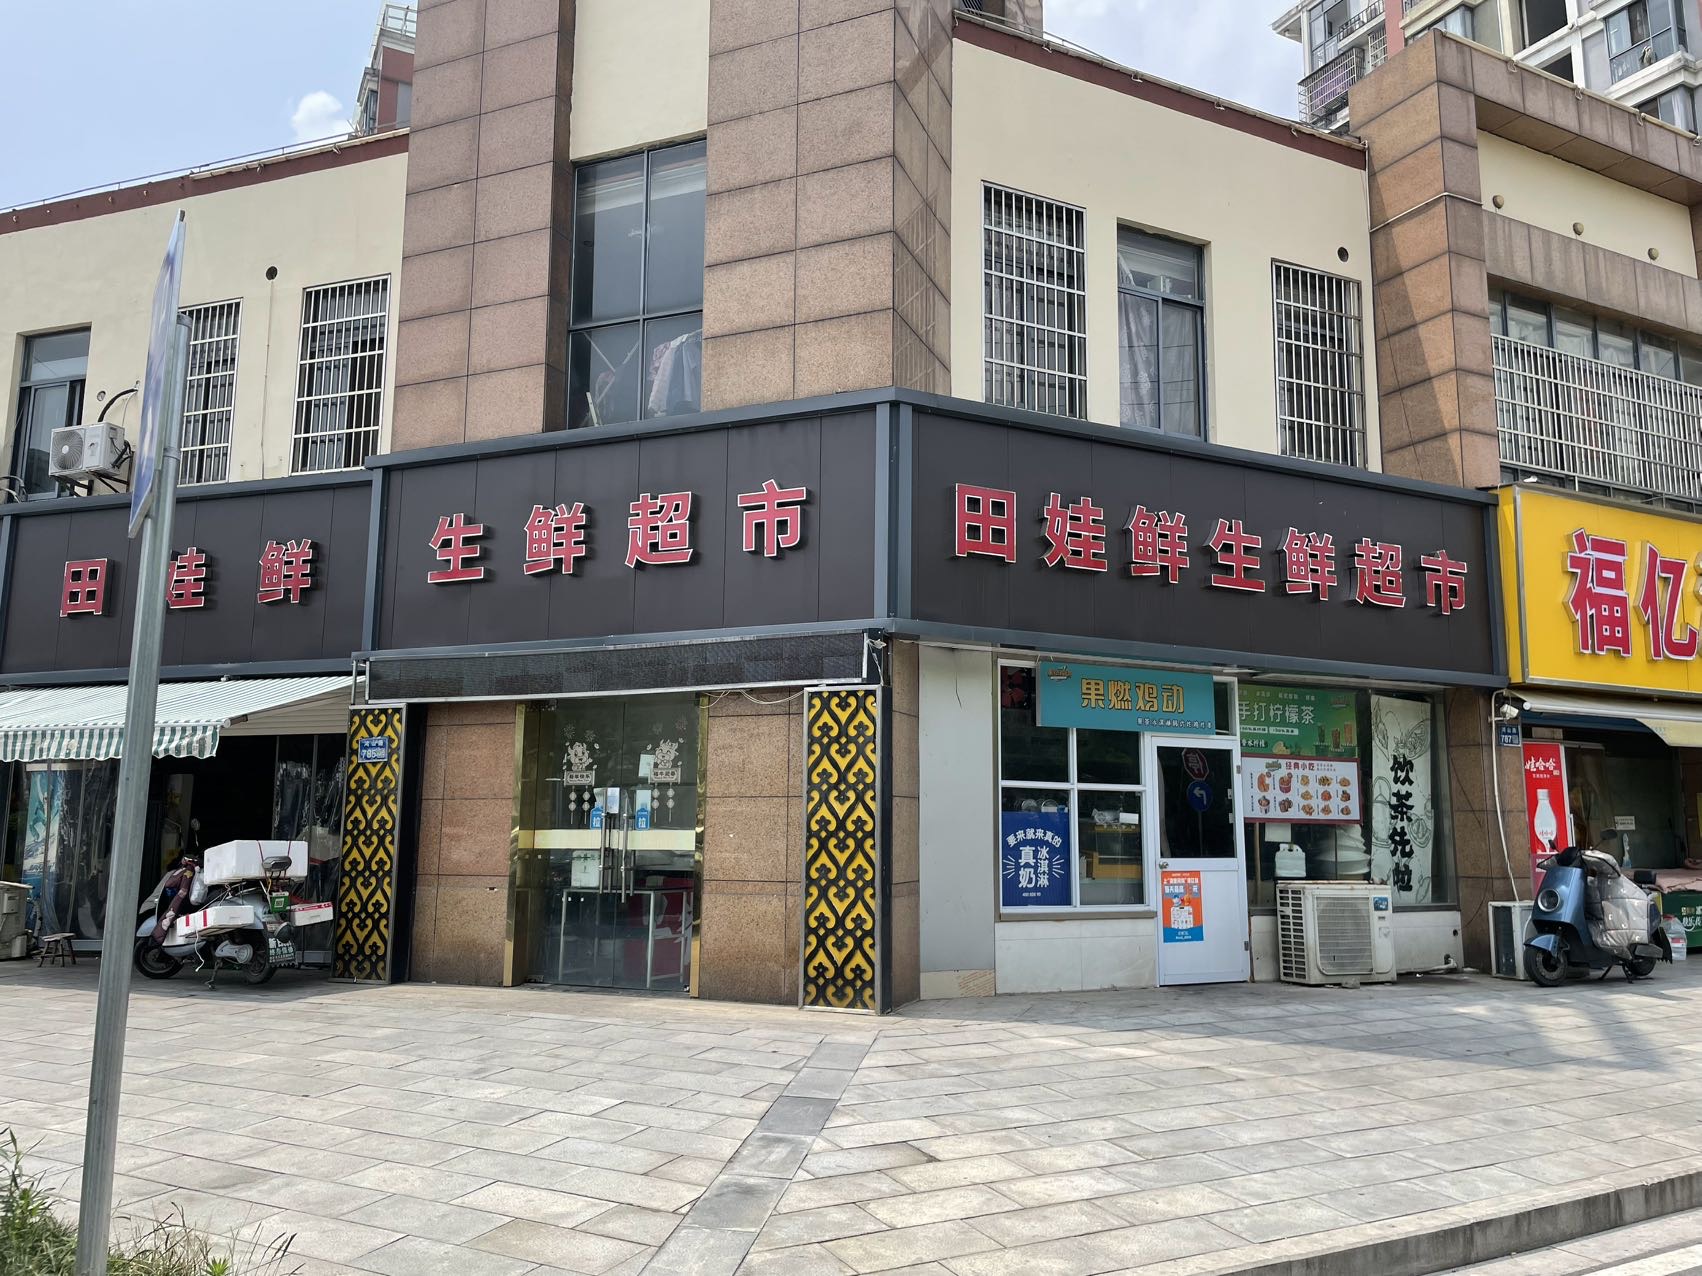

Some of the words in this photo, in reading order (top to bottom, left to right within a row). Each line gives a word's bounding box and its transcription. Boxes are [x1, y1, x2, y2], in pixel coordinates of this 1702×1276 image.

[427, 478, 807, 584] 生鲜超市
[954, 483, 1468, 616] 田娃鲜生鲜超市
[60, 538, 313, 618] 田娃鲜
[1565, 528, 1702, 661] 福亿
[1081, 678, 1185, 713] 果燃鸡动
[361, 749, 377, 759] 785
[1286, 761, 1315, 771] 经典小吃
[1525, 756, 1556, 771] 娃哈哈
[1006, 828, 1062, 848] 要来就来真的
[1019, 845, 1036, 888] 真奶
[1037, 845, 1049, 888] 冰淇淋
